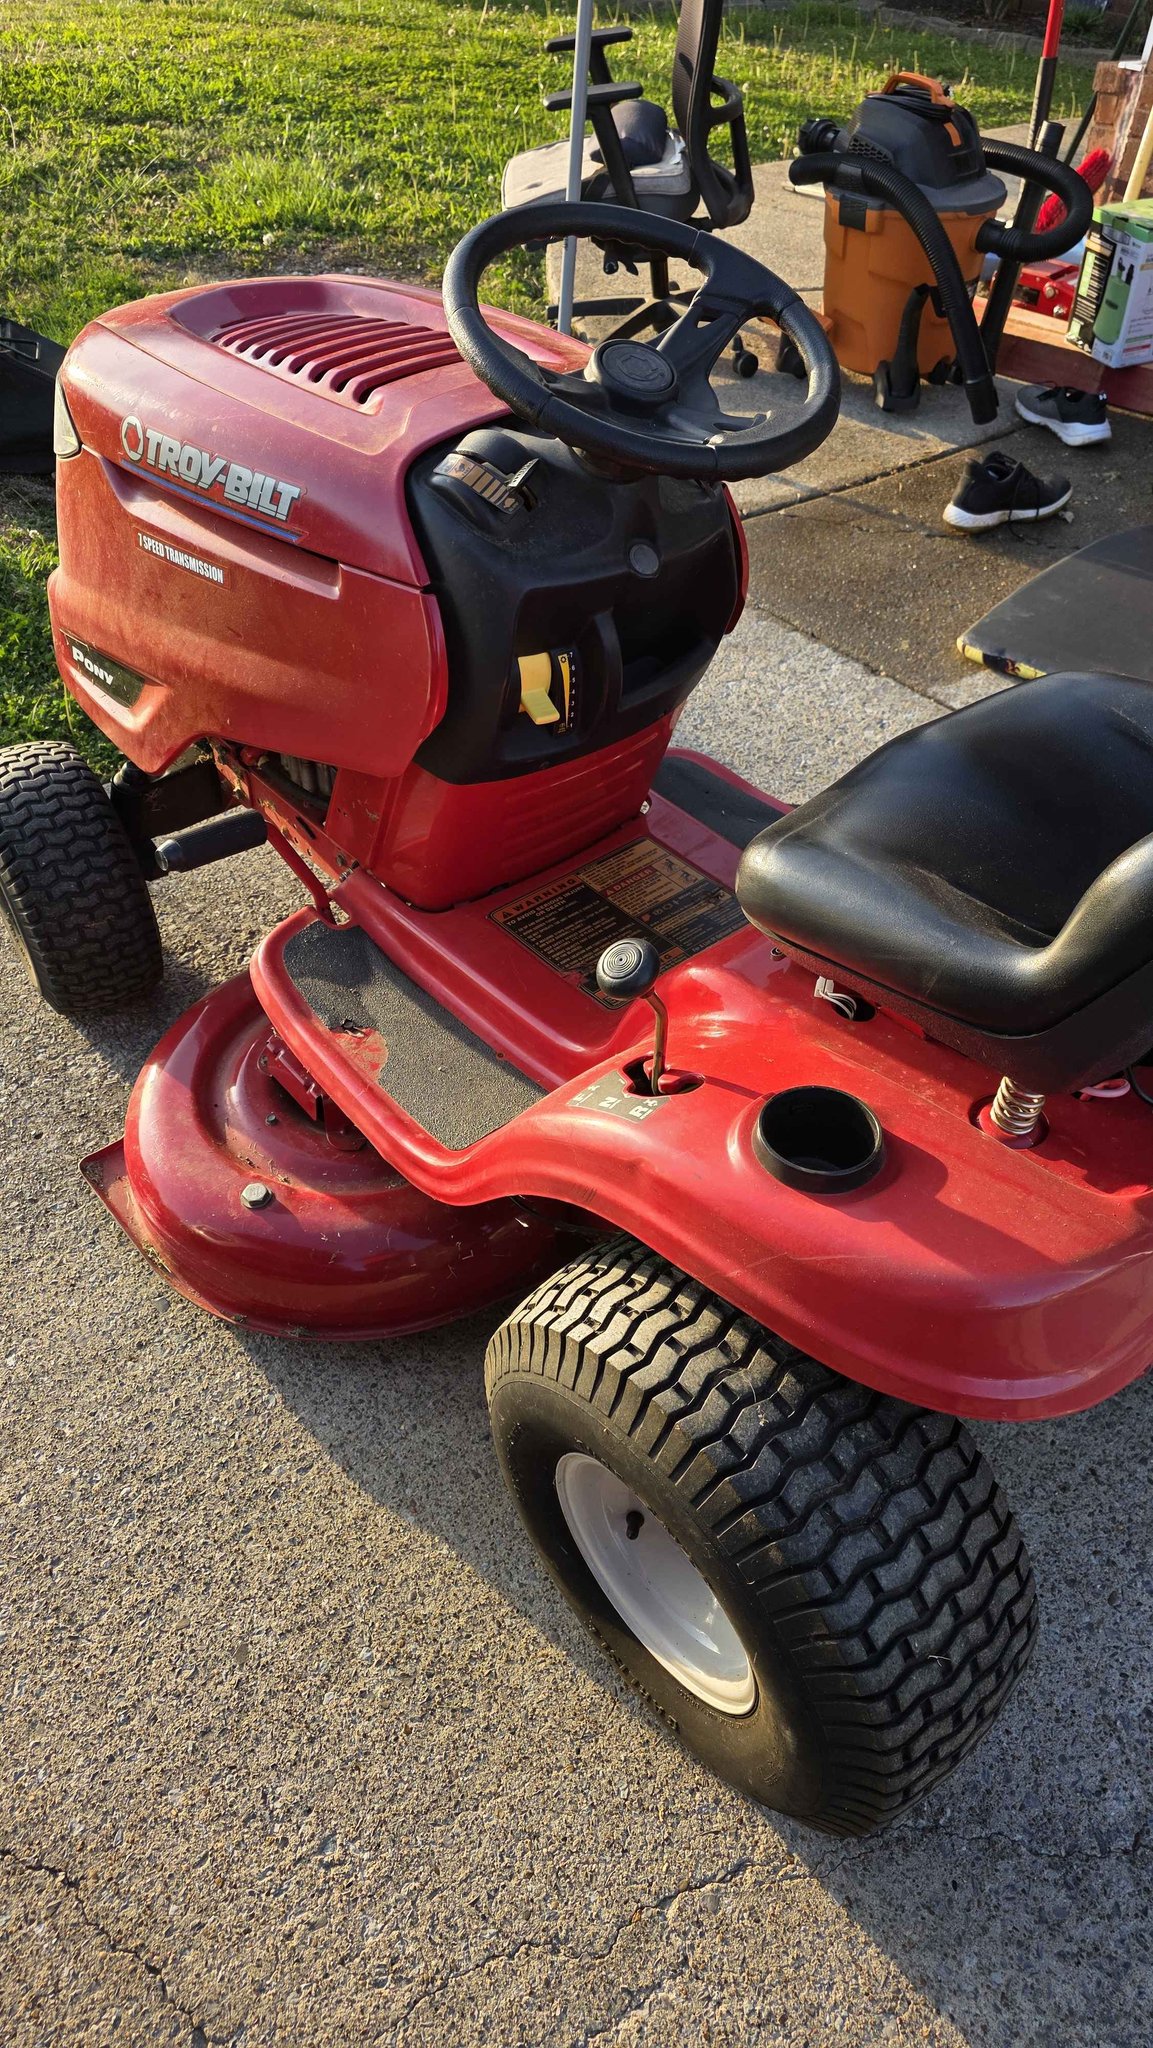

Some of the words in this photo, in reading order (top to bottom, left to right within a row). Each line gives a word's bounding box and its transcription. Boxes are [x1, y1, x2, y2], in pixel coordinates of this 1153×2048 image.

[145, 427, 301, 521] TROY-BILT
[142, 535, 165, 558] SPEED
[164, 545, 224, 584] TRANSMISSION
[613, 868, 653, 891] DANGER
[512, 877, 577, 913] WARNING
[598, 1096, 618, 1107] N
[629, 1105, 649, 1118] R
